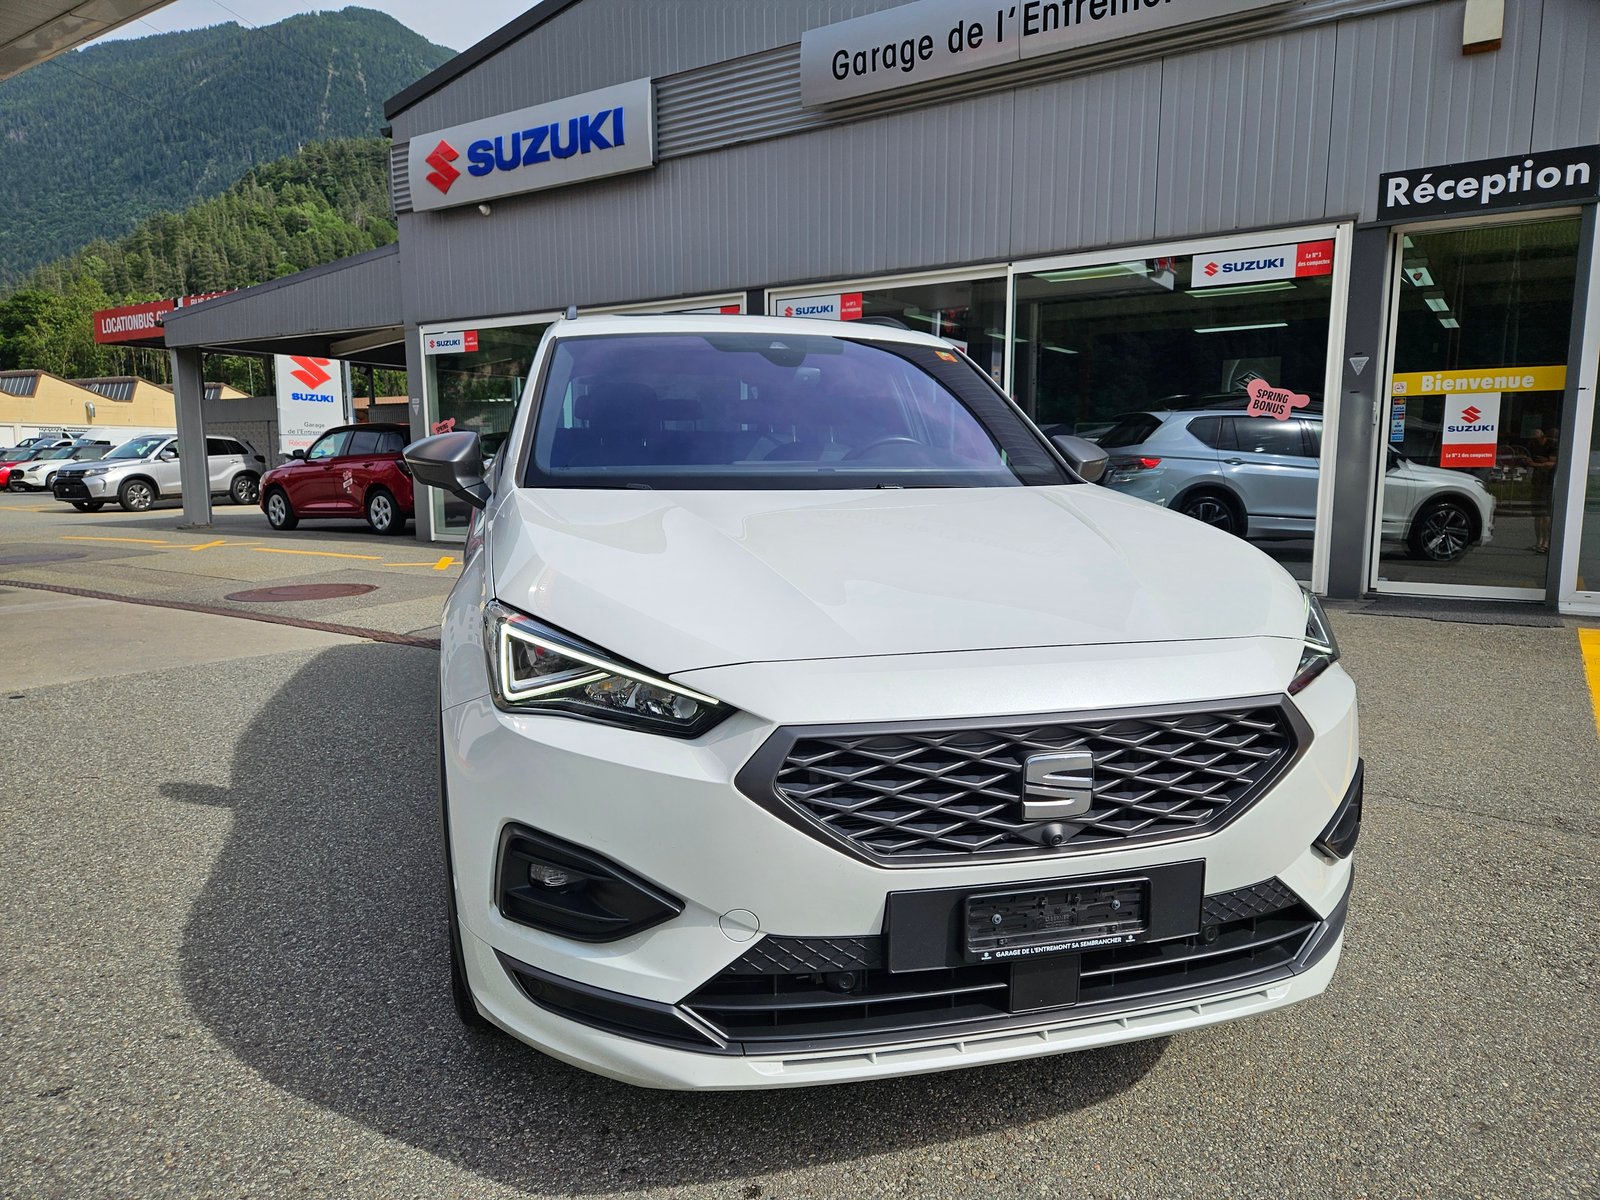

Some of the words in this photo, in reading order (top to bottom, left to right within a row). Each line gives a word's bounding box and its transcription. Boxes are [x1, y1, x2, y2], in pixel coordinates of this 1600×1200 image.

[831, 34, 934, 81] Garage
[947, 19, 984, 54] de
[466, 106, 626, 177] SUZUKI
[1385, 158, 1591, 208] Réception
[1222, 257, 1285, 273] SUZUKI
[795, 304, 834, 316] SUZUKI
[436, 339, 461, 348] SUZUKI
[1421, 374, 1535, 392] Bienvenue
[291, 392, 335, 403] SUZUKI
[1256, 388, 1290, 404] SPRING
[1252, 399, 1286, 415] BONUS
[303, 421, 325, 429] Garage
[1447, 424, 1495, 433] SUZUKI
[995, 948, 1021, 958] GARAGE
[1021, 947, 1030, 955] DE
[1030, 943, 1072, 954] L'ENTREMONT
[1079, 936, 1122, 948] SEMBRANCHER
